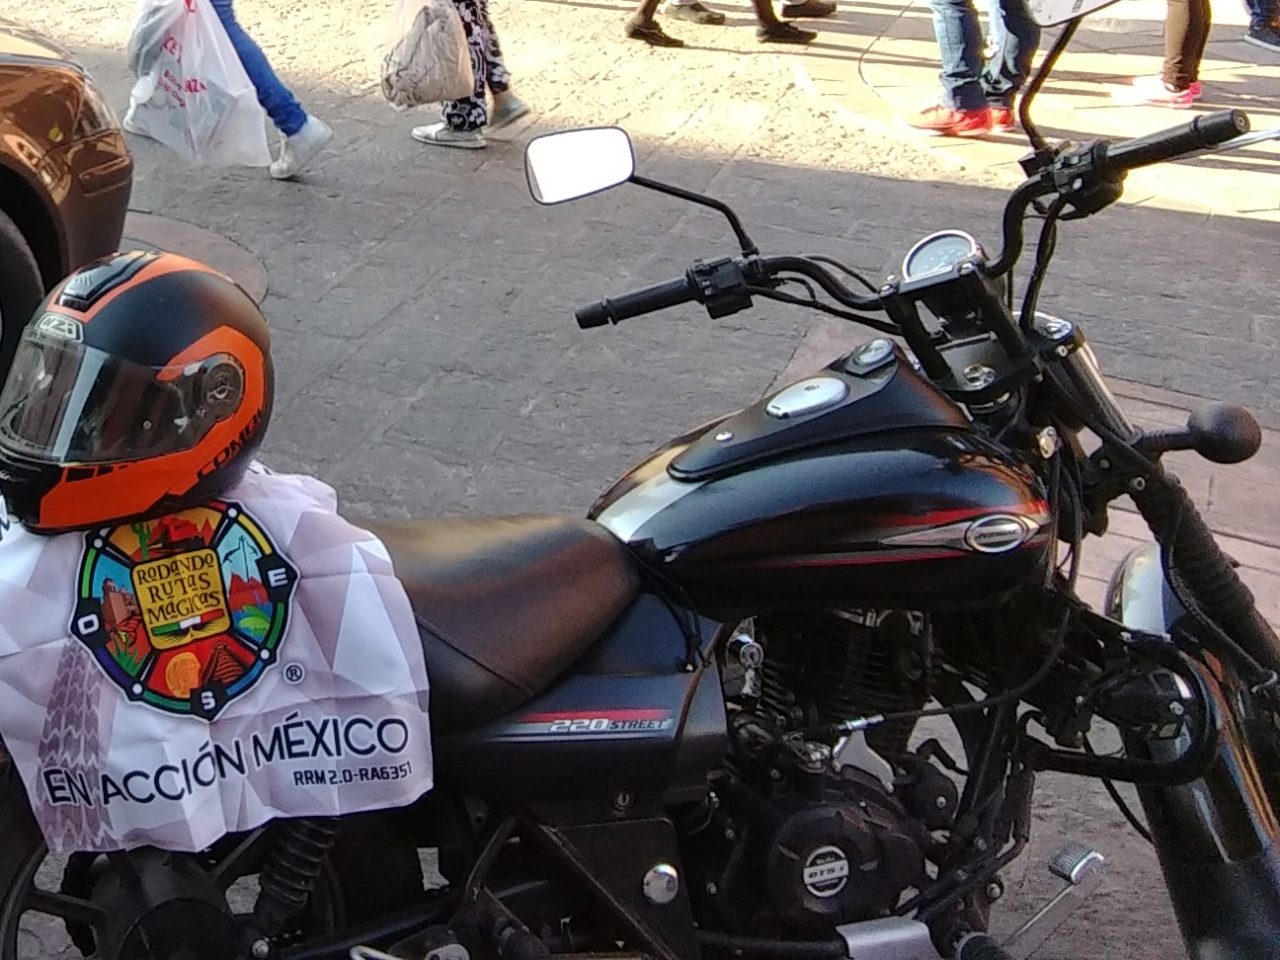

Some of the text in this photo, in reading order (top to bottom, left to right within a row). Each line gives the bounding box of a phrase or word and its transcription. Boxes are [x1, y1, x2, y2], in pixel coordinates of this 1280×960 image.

[268, 568, 288, 587] E
[77, 614, 100, 635] O
[201, 692, 216, 710] S
[551, 718, 666, 732] 220 STREET
[43, 712, 409, 806] EN ACCIÓN MÉXICO
